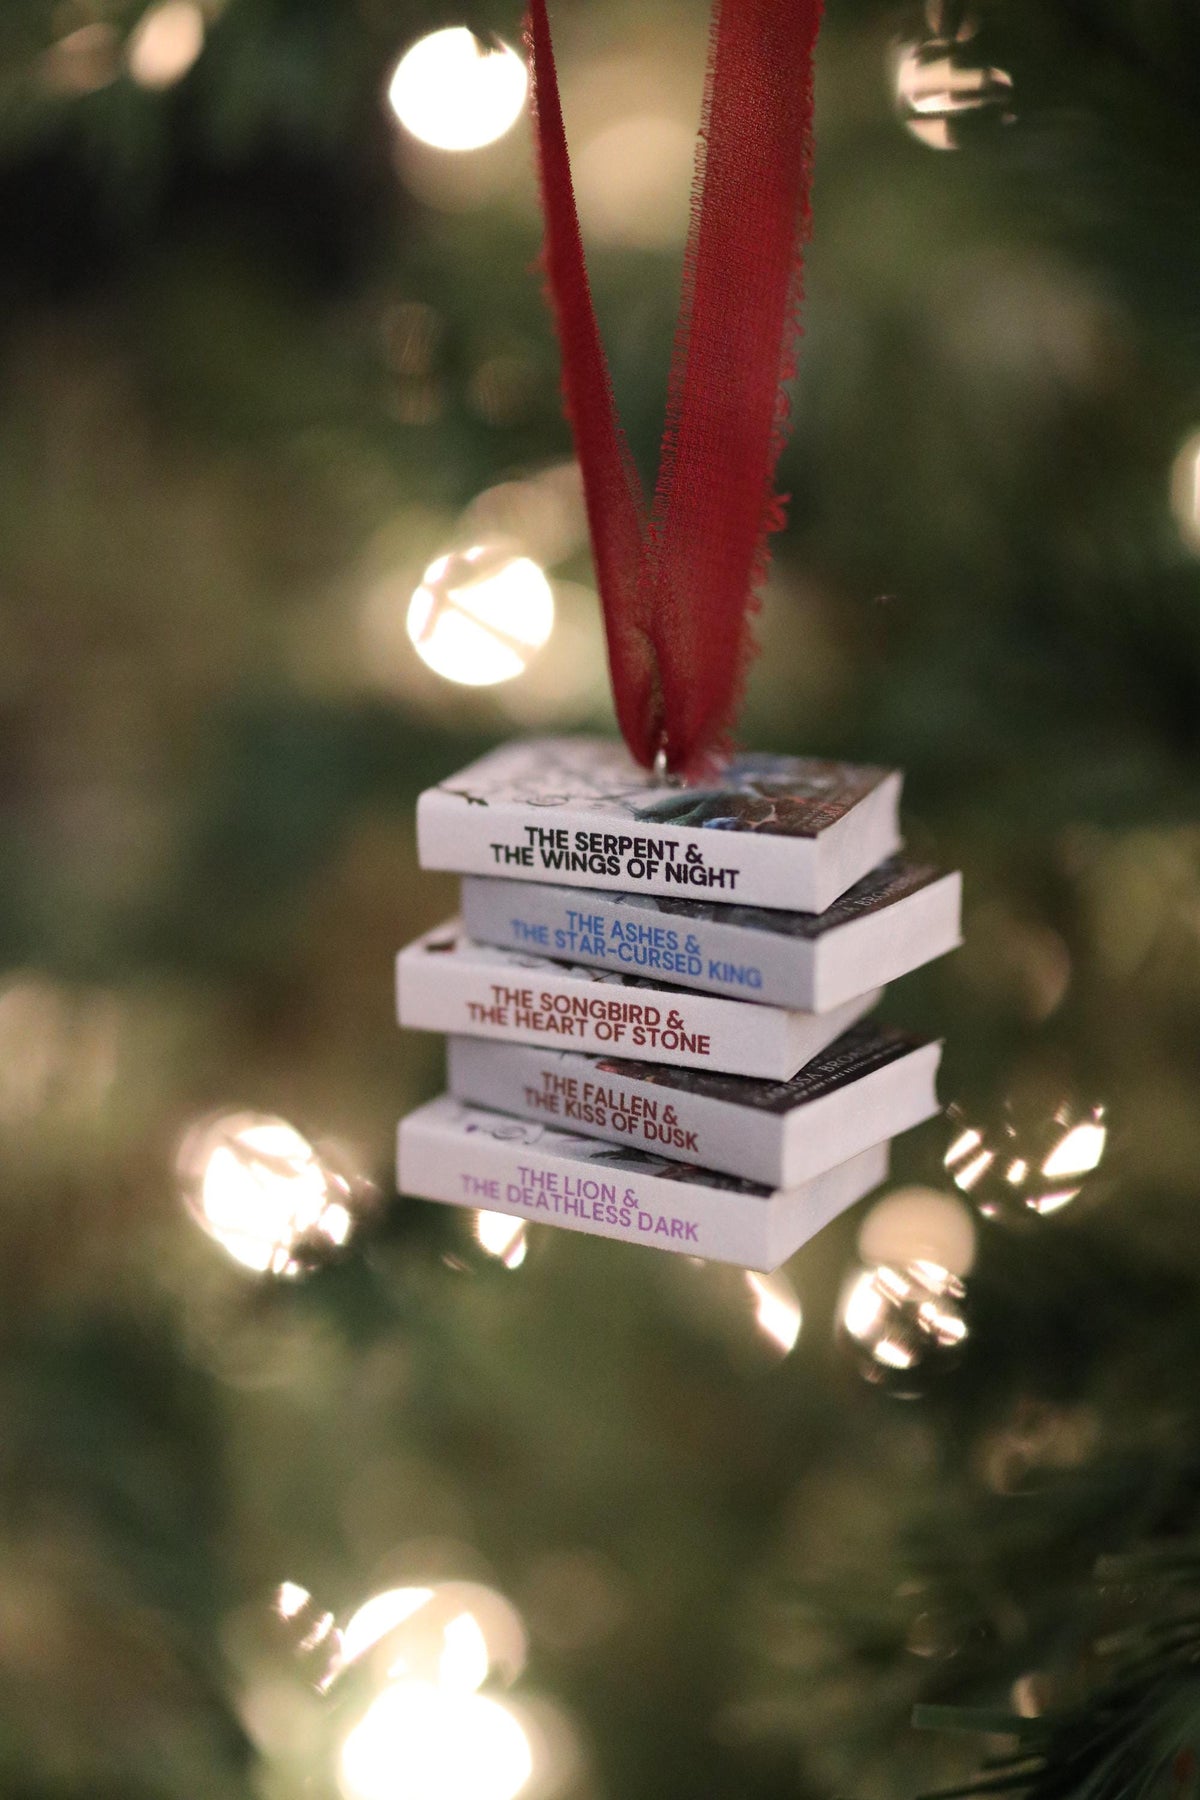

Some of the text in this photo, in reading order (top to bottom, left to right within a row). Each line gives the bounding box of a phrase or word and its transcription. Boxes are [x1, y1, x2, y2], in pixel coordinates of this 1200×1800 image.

[490, 844, 740, 890] THE WINGS OF NIGHT
[524, 826, 704, 865] THE SERPENT &
[510, 919, 764, 989] THE STAR-CURSED KING
[566, 910, 701, 955] THE ASHES &
[467, 1002, 711, 1055] THE HEART OF STONE
[491, 985, 684, 1030] THE SONGBIRD &
[524, 1087, 699, 1152] THE KISS OF DUSK
[541, 1071, 678, 1126] THE FALLEN &
[461, 1174, 699, 1242] THE DEATHLESS DARK
[517, 1166, 639, 1209] THE LION &
